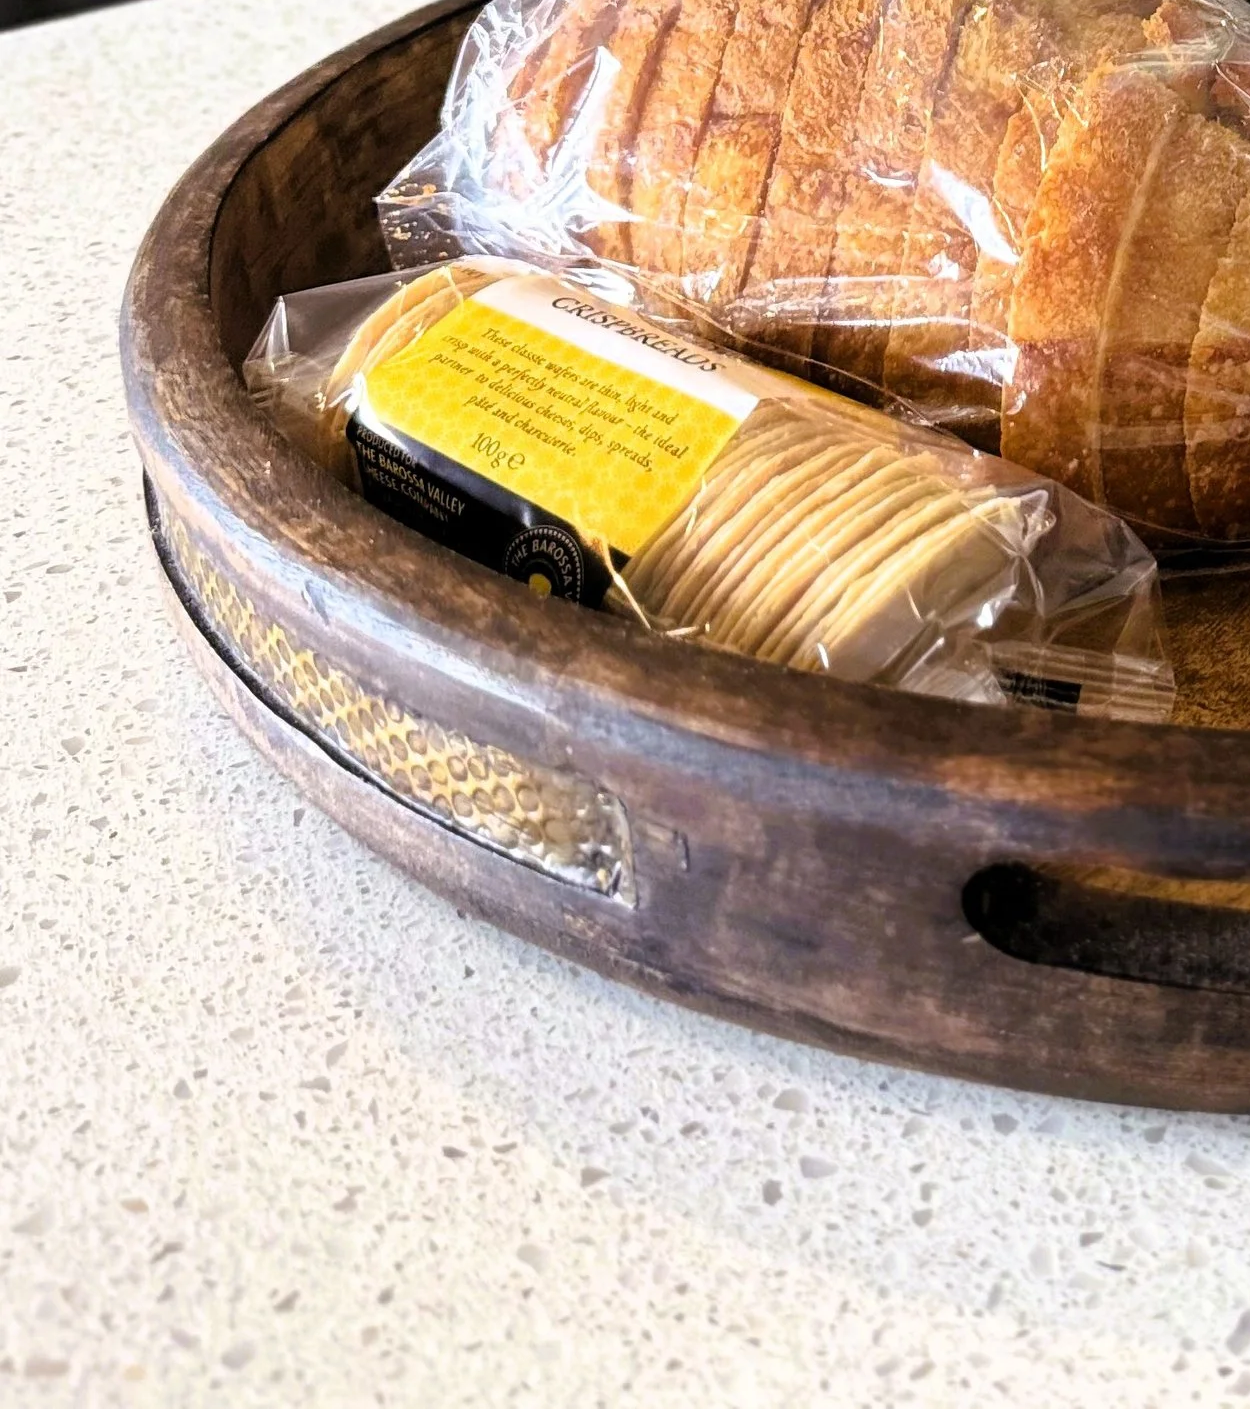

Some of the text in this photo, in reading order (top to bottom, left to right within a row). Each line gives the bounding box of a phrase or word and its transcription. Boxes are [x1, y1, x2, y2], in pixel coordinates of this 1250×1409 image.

[441, 335, 468, 353] crisp
[552, 297, 726, 372] CRISPBREADS
[468, 346, 496, 363] with
[491, 359, 501, 367] a
[481, 327, 512, 348] These
[511, 343, 546, 366] classic
[545, 362, 579, 383] wafers
[579, 378, 599, 390] are
[625, 394, 652, 413] light
[651, 411, 679, 426] and
[494, 363, 547, 392] perfectly
[546, 386, 590, 409] neutral
[428, 353, 654, 474] partner to delicious cheeses, dips, spreads,
[579, 401, 625, 425] flavour
[356, 426, 400, 458] PRODUCED
[492, 408, 519, 423] and
[514, 418, 577, 457] charcuterie.
[633, 425, 653, 441] the
[653, 435, 689, 459] ideal
[356, 441, 466, 516] THE BAROSSA VALLEY
[512, 539, 573, 587] THE BAROSSA
